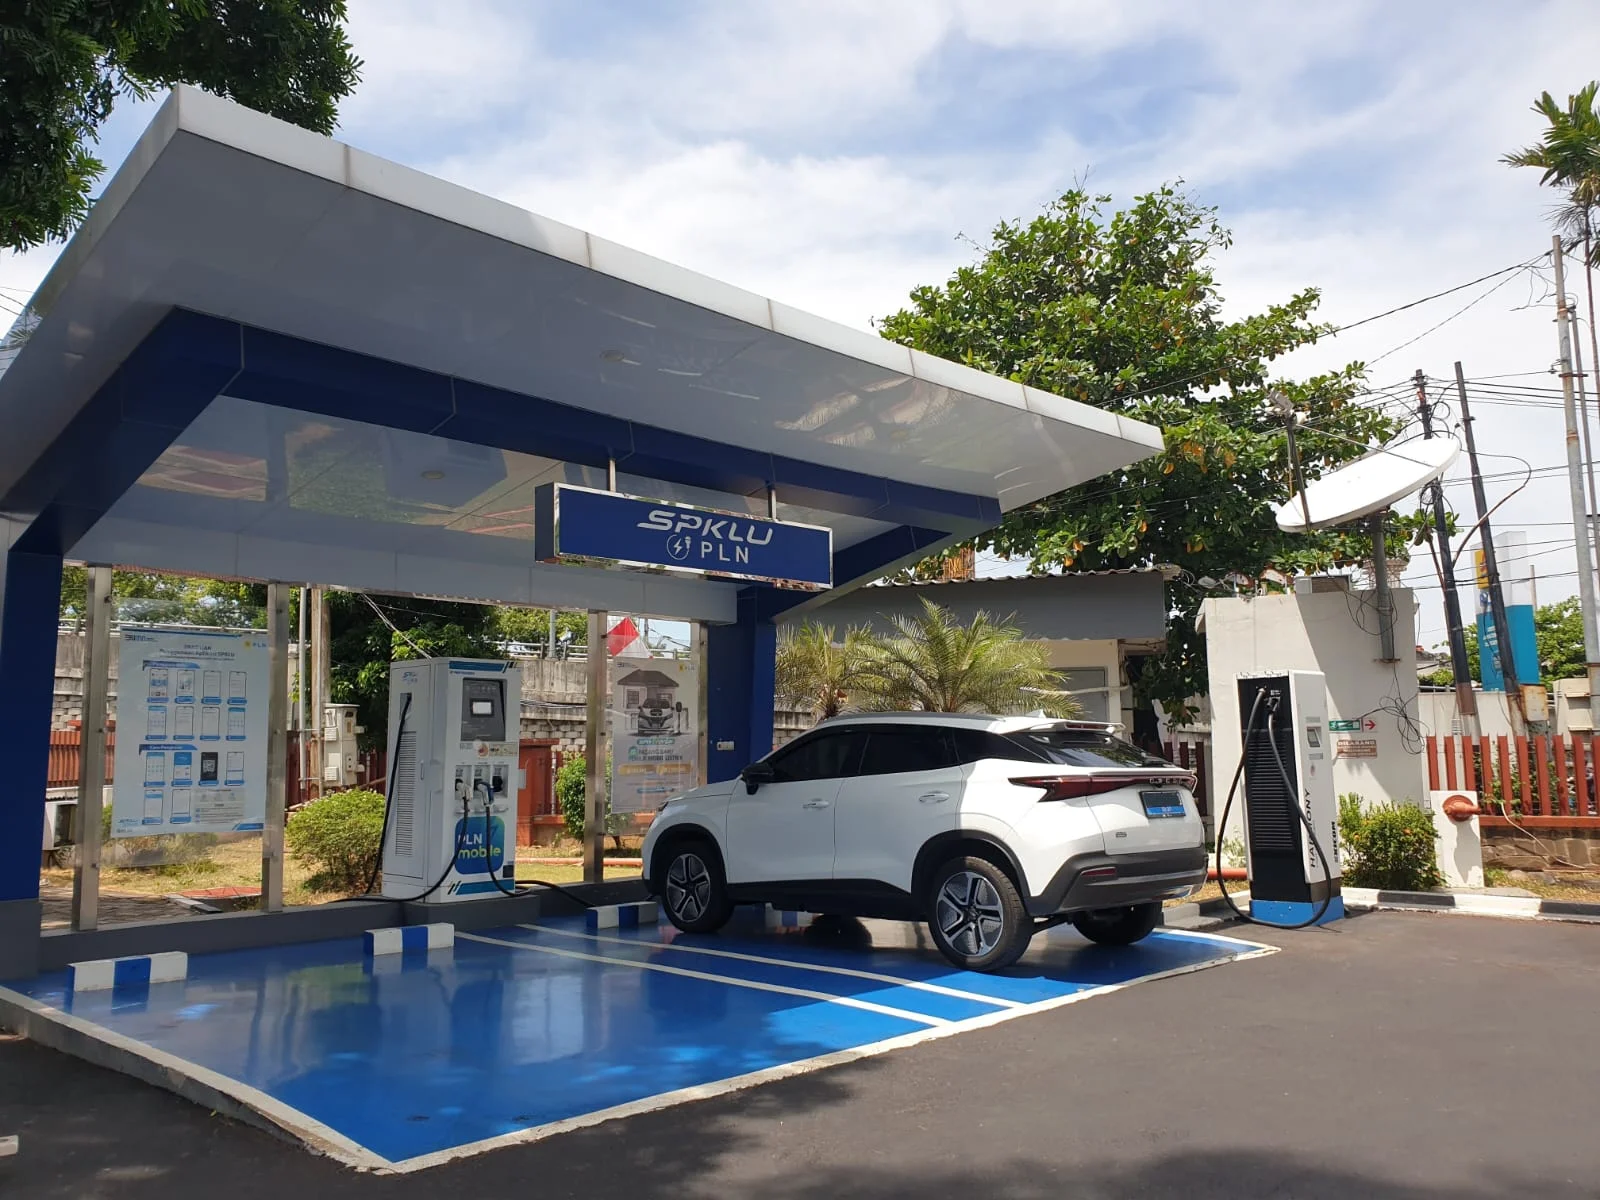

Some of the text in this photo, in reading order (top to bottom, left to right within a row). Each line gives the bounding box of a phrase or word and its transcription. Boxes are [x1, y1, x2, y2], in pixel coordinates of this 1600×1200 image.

[637, 510, 773, 545] SPKLU
[701, 541, 748, 564] PLN
[1304, 787, 1316, 868] HAONY
[457, 845, 502, 859] moble
